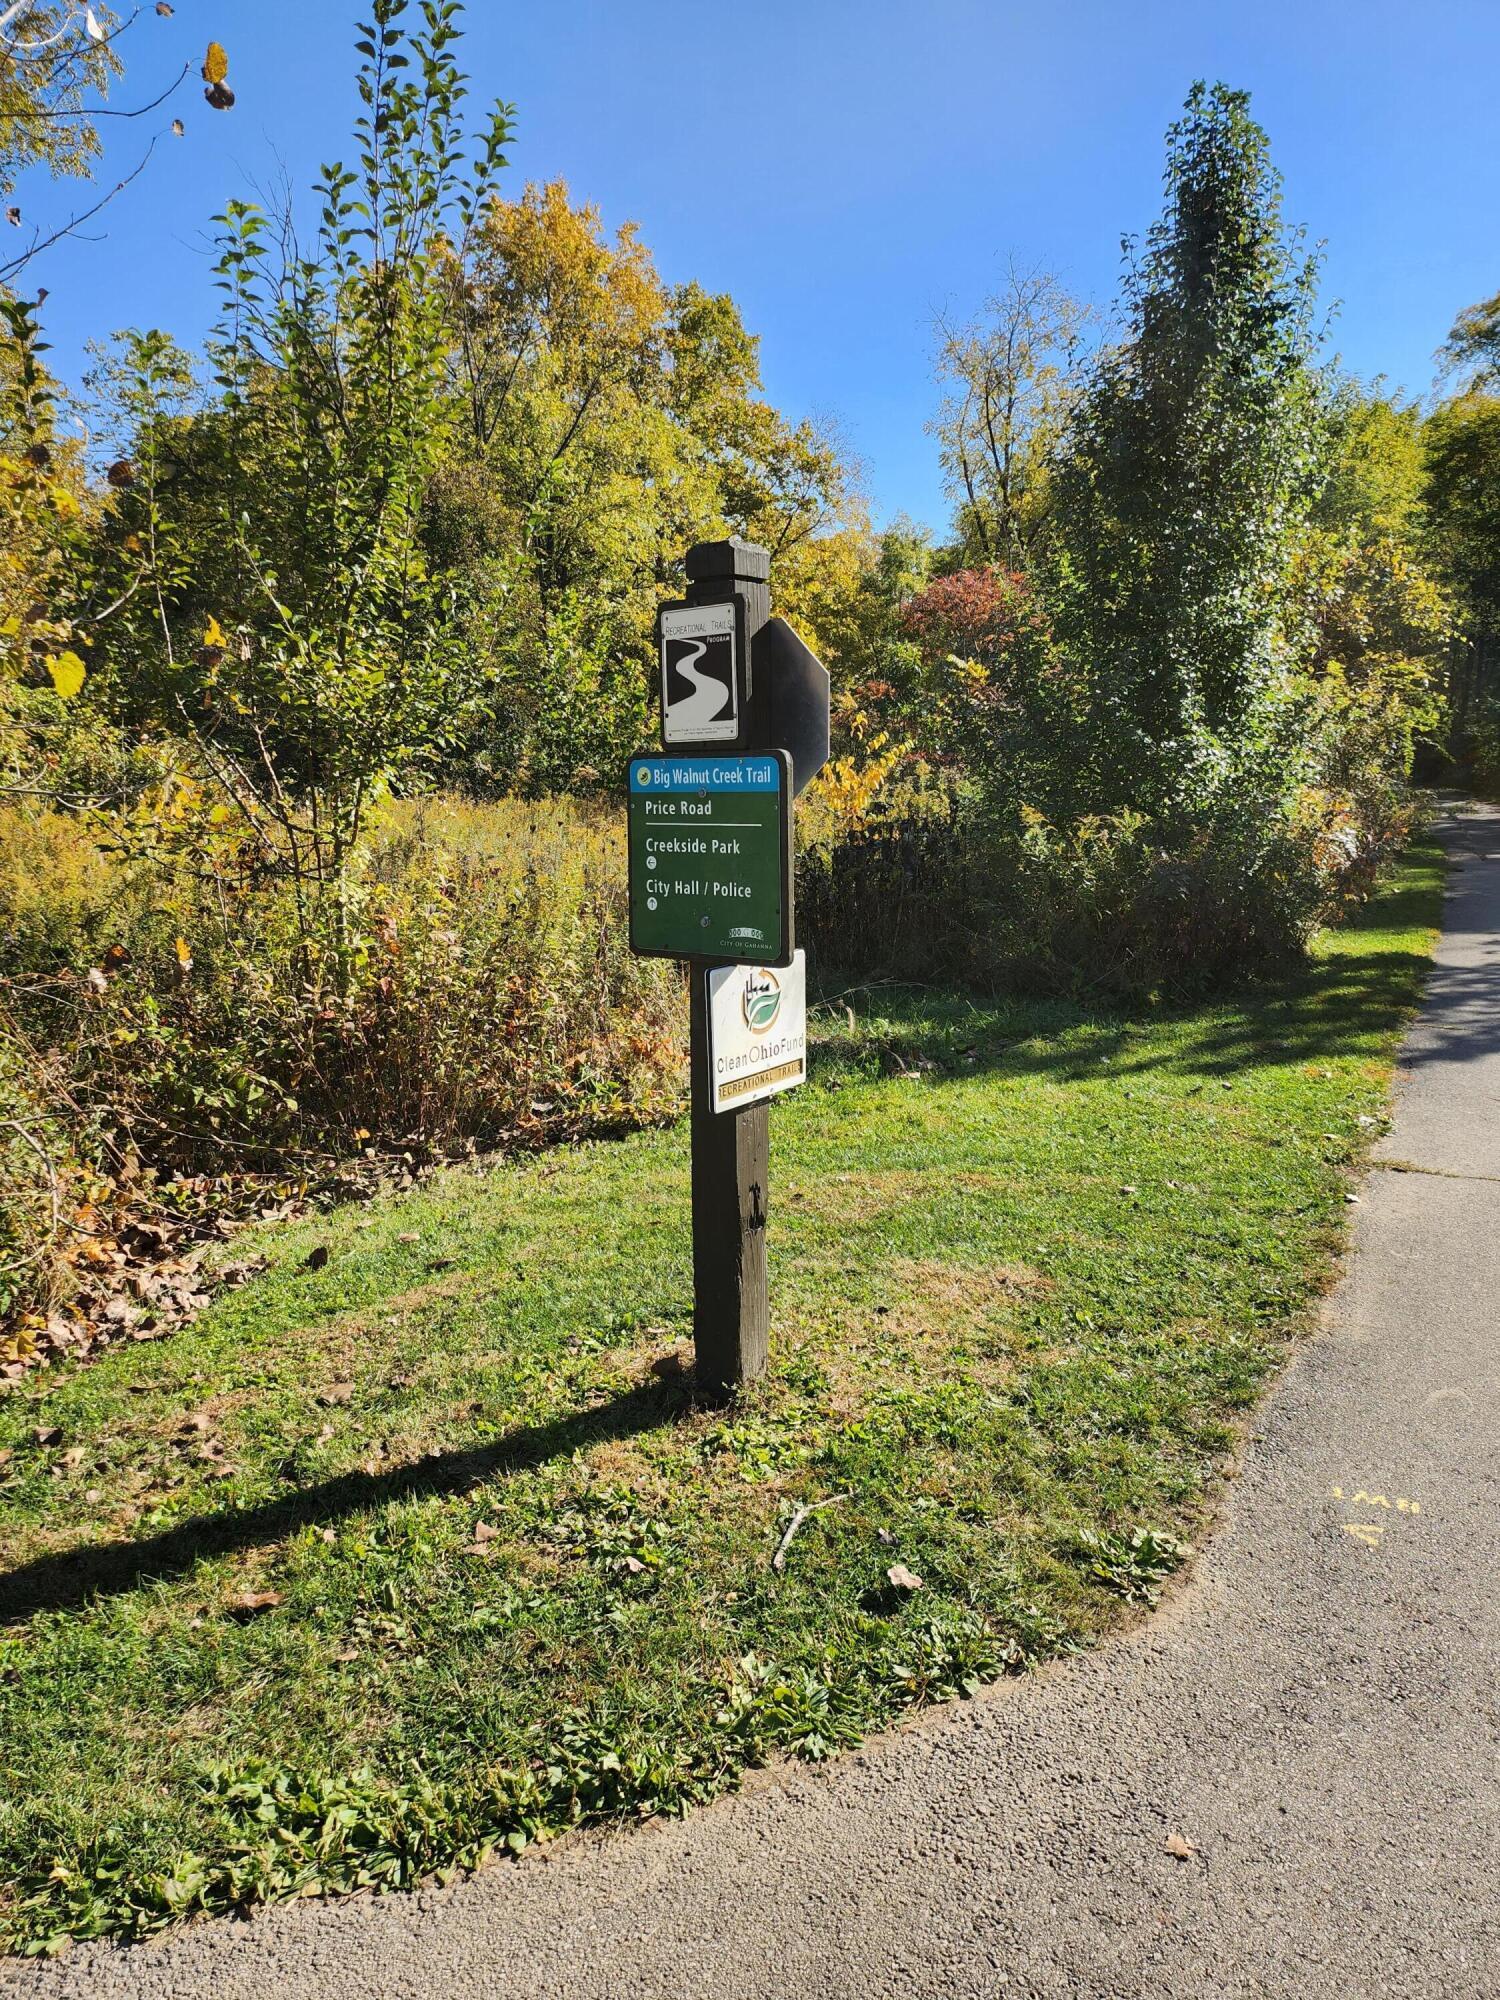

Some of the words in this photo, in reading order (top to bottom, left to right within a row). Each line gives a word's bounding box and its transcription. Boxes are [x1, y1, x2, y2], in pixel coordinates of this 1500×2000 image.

[666, 623, 706, 635] RECREATIONAL
[711, 620, 732, 630] TRAILS
[706, 635, 731, 643] PROGRAM
[654, 770, 669, 788] Big
[673, 769, 709, 784] Walnut
[713, 767, 743, 783] Creek
[745, 766, 770, 783] Trail
[646, 801, 675, 815] Price
[681, 800, 712, 815] Road
[646, 838, 706, 853] Creekside
[712, 840, 740, 854] Park
[646, 880, 670, 896] City
[675, 881, 699, 895] Hall
[713, 883, 752, 897] Police
